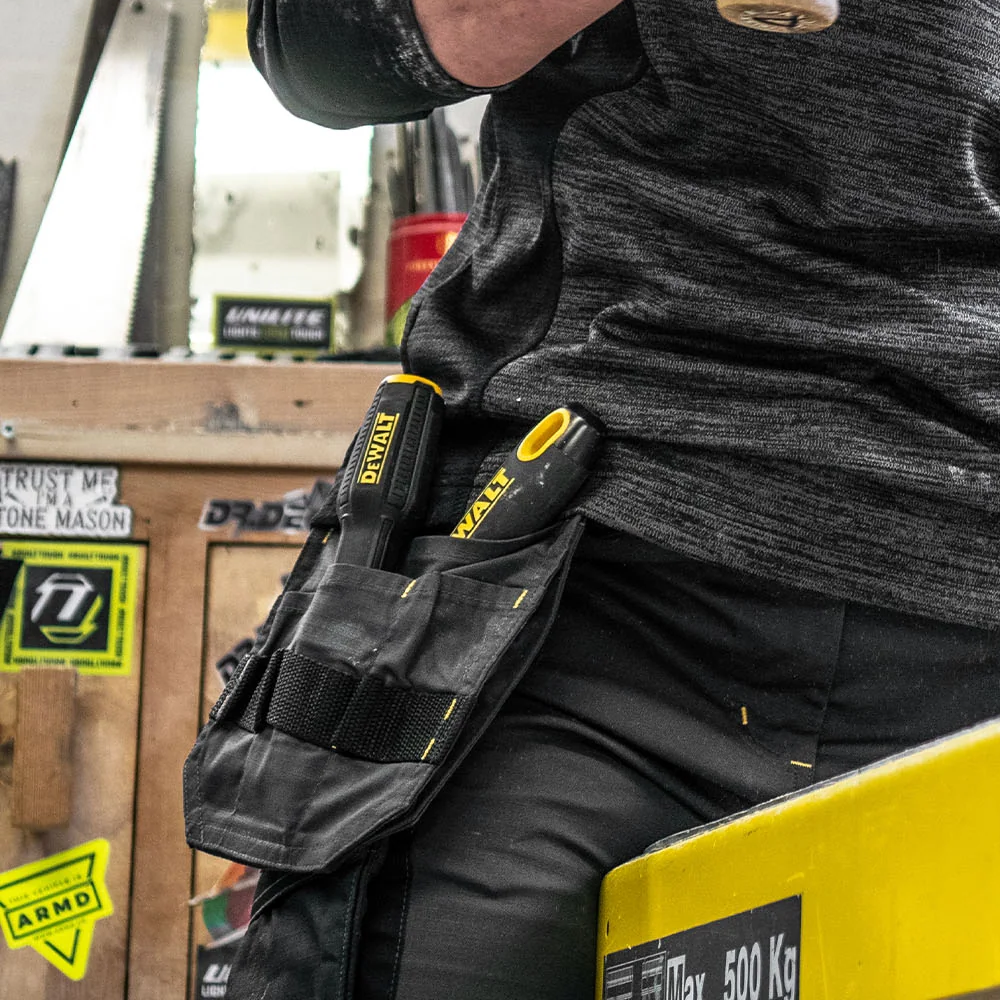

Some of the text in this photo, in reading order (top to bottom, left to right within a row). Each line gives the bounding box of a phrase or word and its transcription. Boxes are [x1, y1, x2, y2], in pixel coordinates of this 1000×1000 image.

[360, 413, 396, 485] DEWALT
[3, 466, 114, 492] TRUST ME
[452, 471, 510, 539] WALT
[56, 508, 125, 530] MASON
[18, 891, 91, 929] ARMD
[666, 933, 797, 1000] Max 500 Kg
